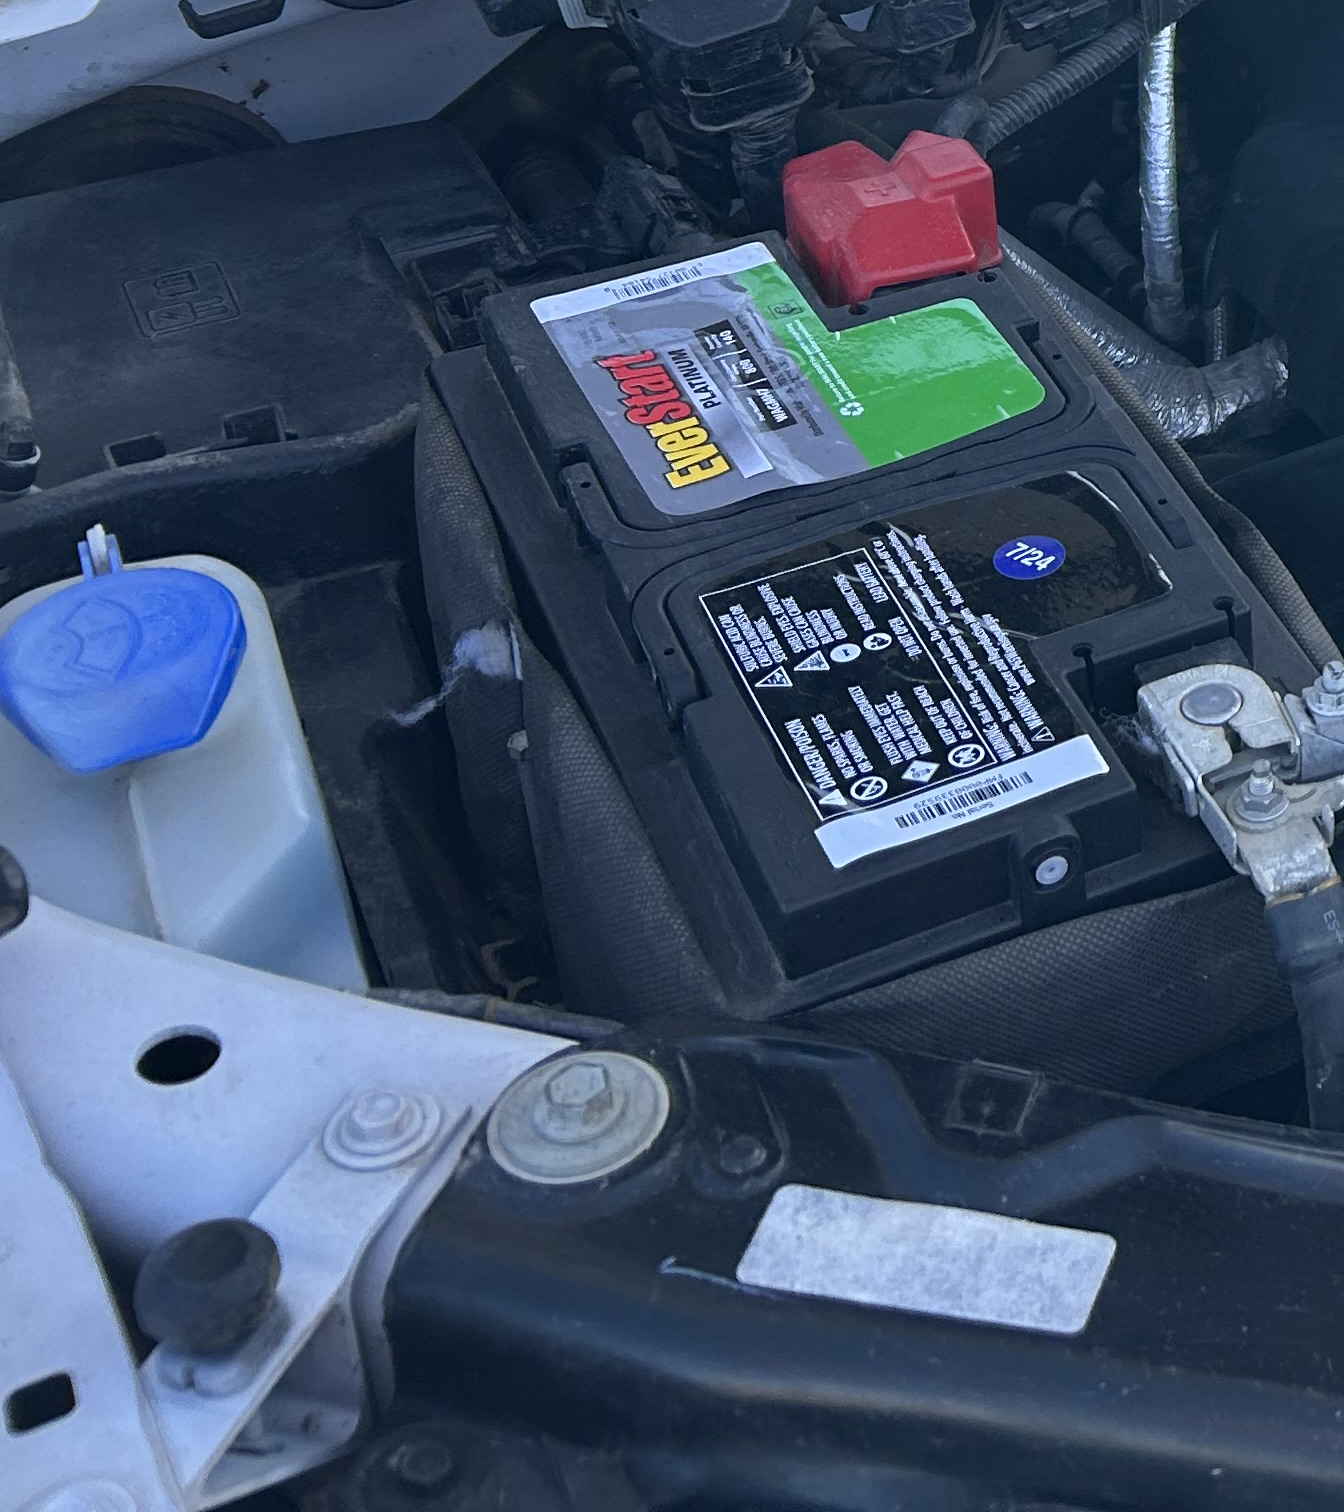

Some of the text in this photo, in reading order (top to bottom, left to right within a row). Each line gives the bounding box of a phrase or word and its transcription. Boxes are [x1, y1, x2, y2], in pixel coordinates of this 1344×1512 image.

[718, 329, 737, 345] 140
[667, 347, 721, 408] PLATINUM
[738, 358, 757, 374] 800
[591, 348, 731, 489] EverStart
[1005, 541, 1056, 571] 7/24
[756, 583, 784, 614] EXPLOSIVE
[832, 573, 875, 630] READ INSTRUCTIONS
[853, 562, 888, 602] LEAD BATTERY
[728, 604, 773, 666] CAUSE BLINDNESS OR
[781, 596, 820, 648] GASES CAN CAUSE
[783, 630, 806, 652] SHIELD
[804, 609, 834, 643] BLINDNESS
[819, 607, 847, 639] OR INJURY
[887, 616, 922, 655] DO NOT OPEN
[717, 614, 758, 671] SULFURIC ACID CAN
[765, 639, 787, 662] SEVERE
[847, 684, 903, 764] FLUSH EYES IMMEDIATELY
[874, 702, 892, 715] GET
[895, 707, 915, 725] HELP
[912, 685, 957, 744] KEEP OUT OF REACH
[939, 698, 973, 739] OF CHILDREN
[1007, 689, 1045, 729] WARNING:
[784, 718, 836, 789] DANGER/POISON
[810, 713, 857, 777] NO SPARKS, FLAMES
[840, 729, 873, 772] OR SMOKING
[896, 739, 917, 759] WITH
[905, 724, 931, 754] MEDICAL
[981, 722, 1016, 760] WARNING:
[966, 801, 994, 816] Serial
